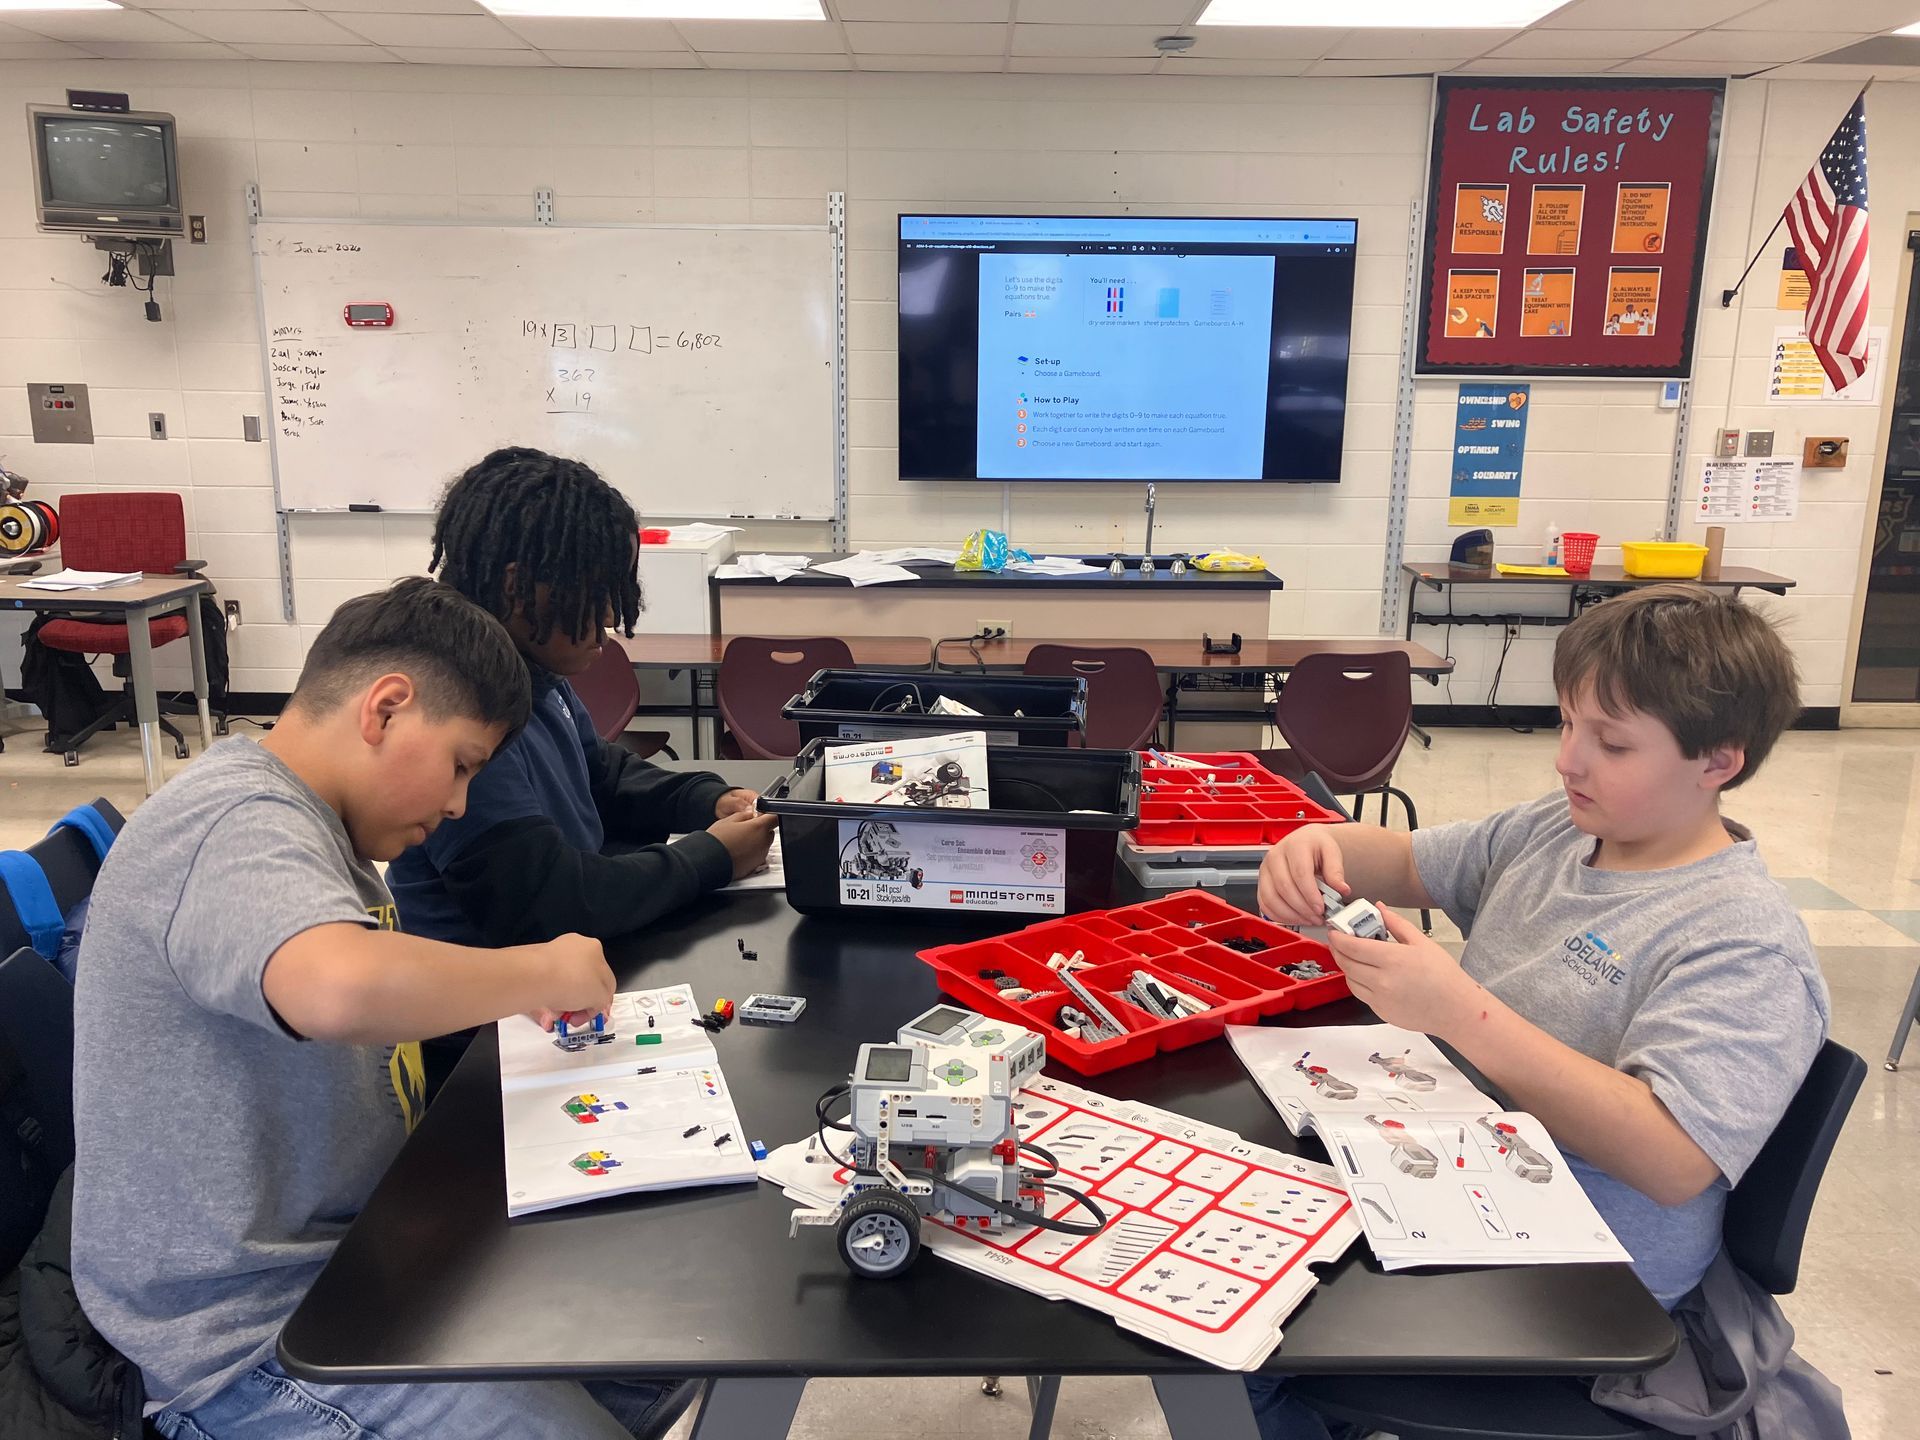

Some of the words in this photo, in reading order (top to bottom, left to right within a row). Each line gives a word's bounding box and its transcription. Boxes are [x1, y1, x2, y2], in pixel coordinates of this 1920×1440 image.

[1468, 103, 1536, 134] Lab
[1561, 106, 1674, 142] Safety
[1508, 142, 1626, 175] Rules!
[292, 241, 314, 254] Jan
[1034, 275, 1045, 284] the
[1004, 293, 1036, 301] equations
[1004, 310, 1022, 318] Pairs
[557, 328, 568, 342] 3
[676, 331, 723, 351] 6,802
[1034, 357, 1061, 366] Set-up
[574, 392, 592, 410] 19
[1034, 396, 1051, 404] How
[1053, 396, 1061, 404] to
[1063, 396, 1080, 405] Play
[1459, 395, 1507, 405] OWNERSHIP
[1050, 411, 1076, 419] together
[1111, 411, 1129, 419] digits
[1185, 412, 1212, 420] equation
[1491, 419, 1521, 428] SWING
[1048, 426, 1062, 434] digit
[1090, 426, 1103, 434] only
[1457, 445, 1499, 455] OPTIMISM
[1472, 471, 1519, 480] SOLIDARITY
[941, 839, 955, 847] Core
[955, 839, 966, 847] Set
[876, 883, 888, 893] 541
[846, 888, 870, 900] 10-21
[1562, 954, 1598, 986] SCHOOLS
[1411, 1230, 1427, 1239] 2
[1515, 1231, 1530, 1240] 3
